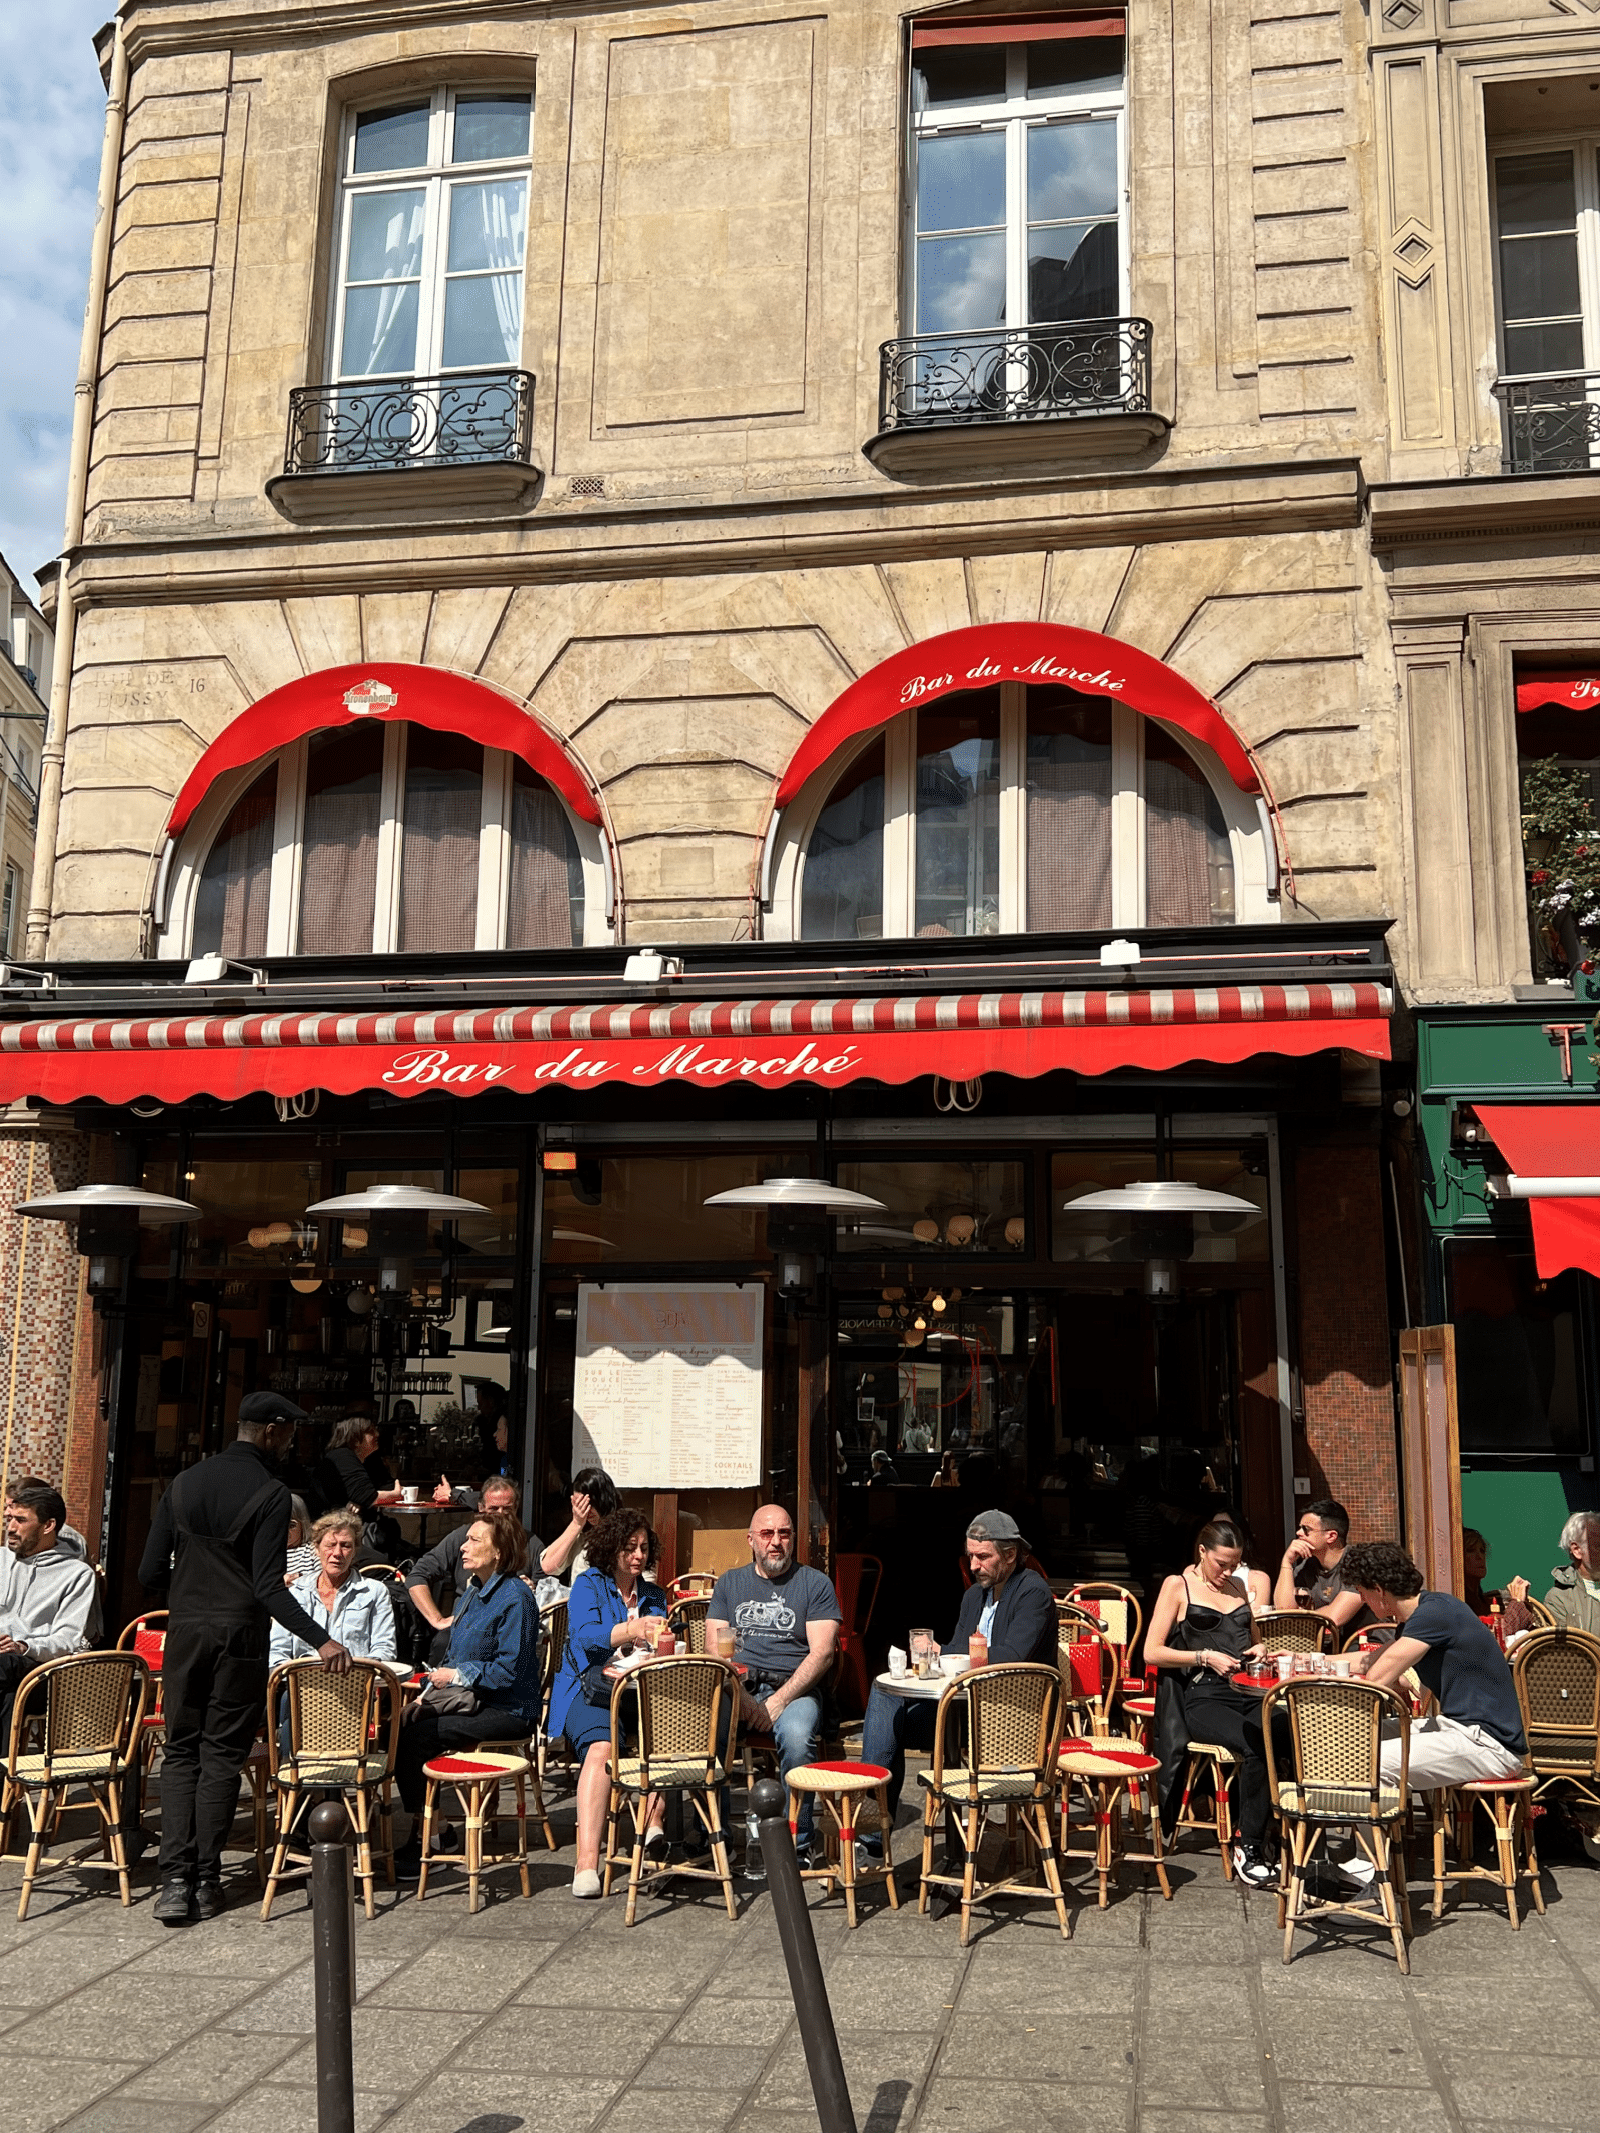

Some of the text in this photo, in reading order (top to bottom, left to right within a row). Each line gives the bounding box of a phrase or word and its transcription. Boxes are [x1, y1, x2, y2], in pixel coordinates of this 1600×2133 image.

[189, 678, 205, 693] 16
[900, 655, 1126, 703] Bar du Marché
[342, 691, 399, 706] Kronenbourg
[381, 1042, 864, 1084] Bar du Marché
[713, 1461, 753, 1470] COCKTAILS
